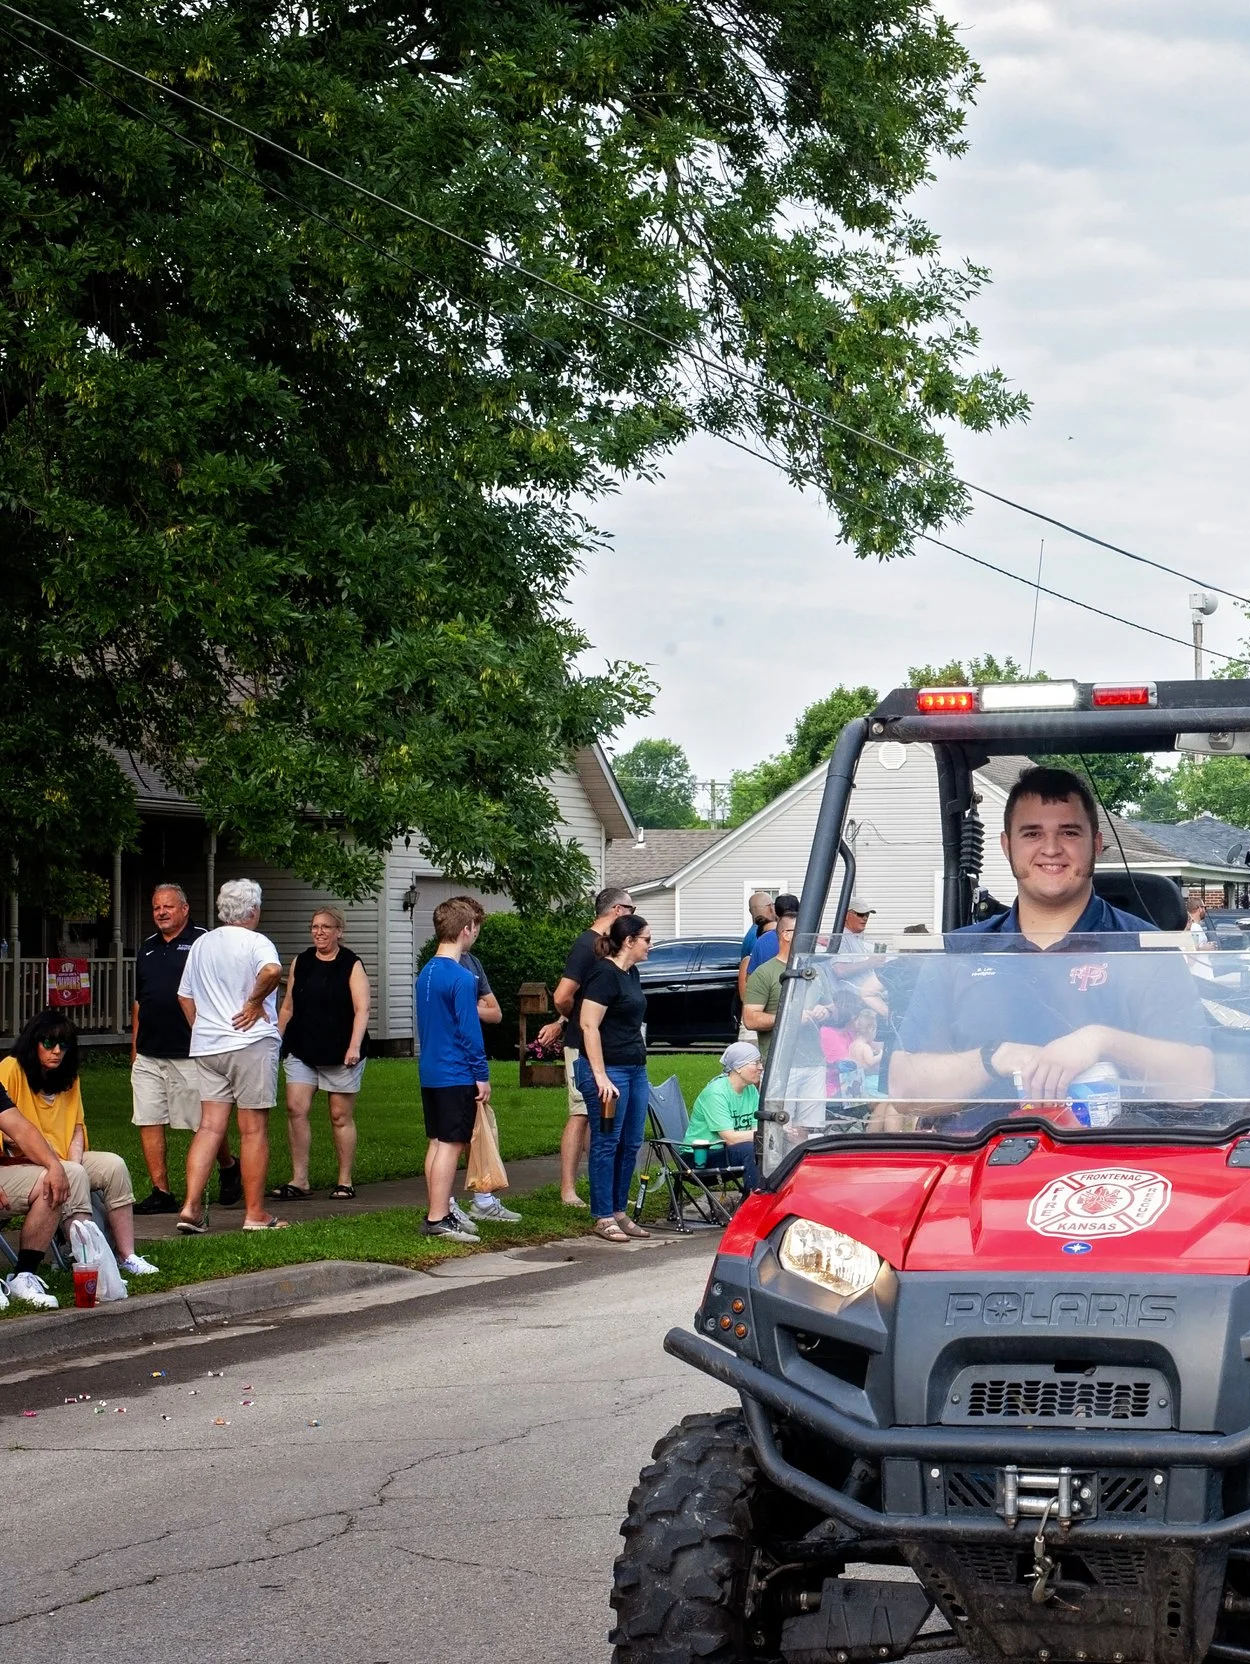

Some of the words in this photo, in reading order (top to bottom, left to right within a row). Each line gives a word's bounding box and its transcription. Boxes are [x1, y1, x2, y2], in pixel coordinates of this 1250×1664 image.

[1080, 1173, 1143, 1182] FRONTENAC
[1040, 1187, 1065, 1217] FIRE
[1135, 1187, 1158, 1219] RESCUE
[1056, 1222, 1118, 1232] KANSAS
[945, 1292, 1178, 1328] POLARIS
